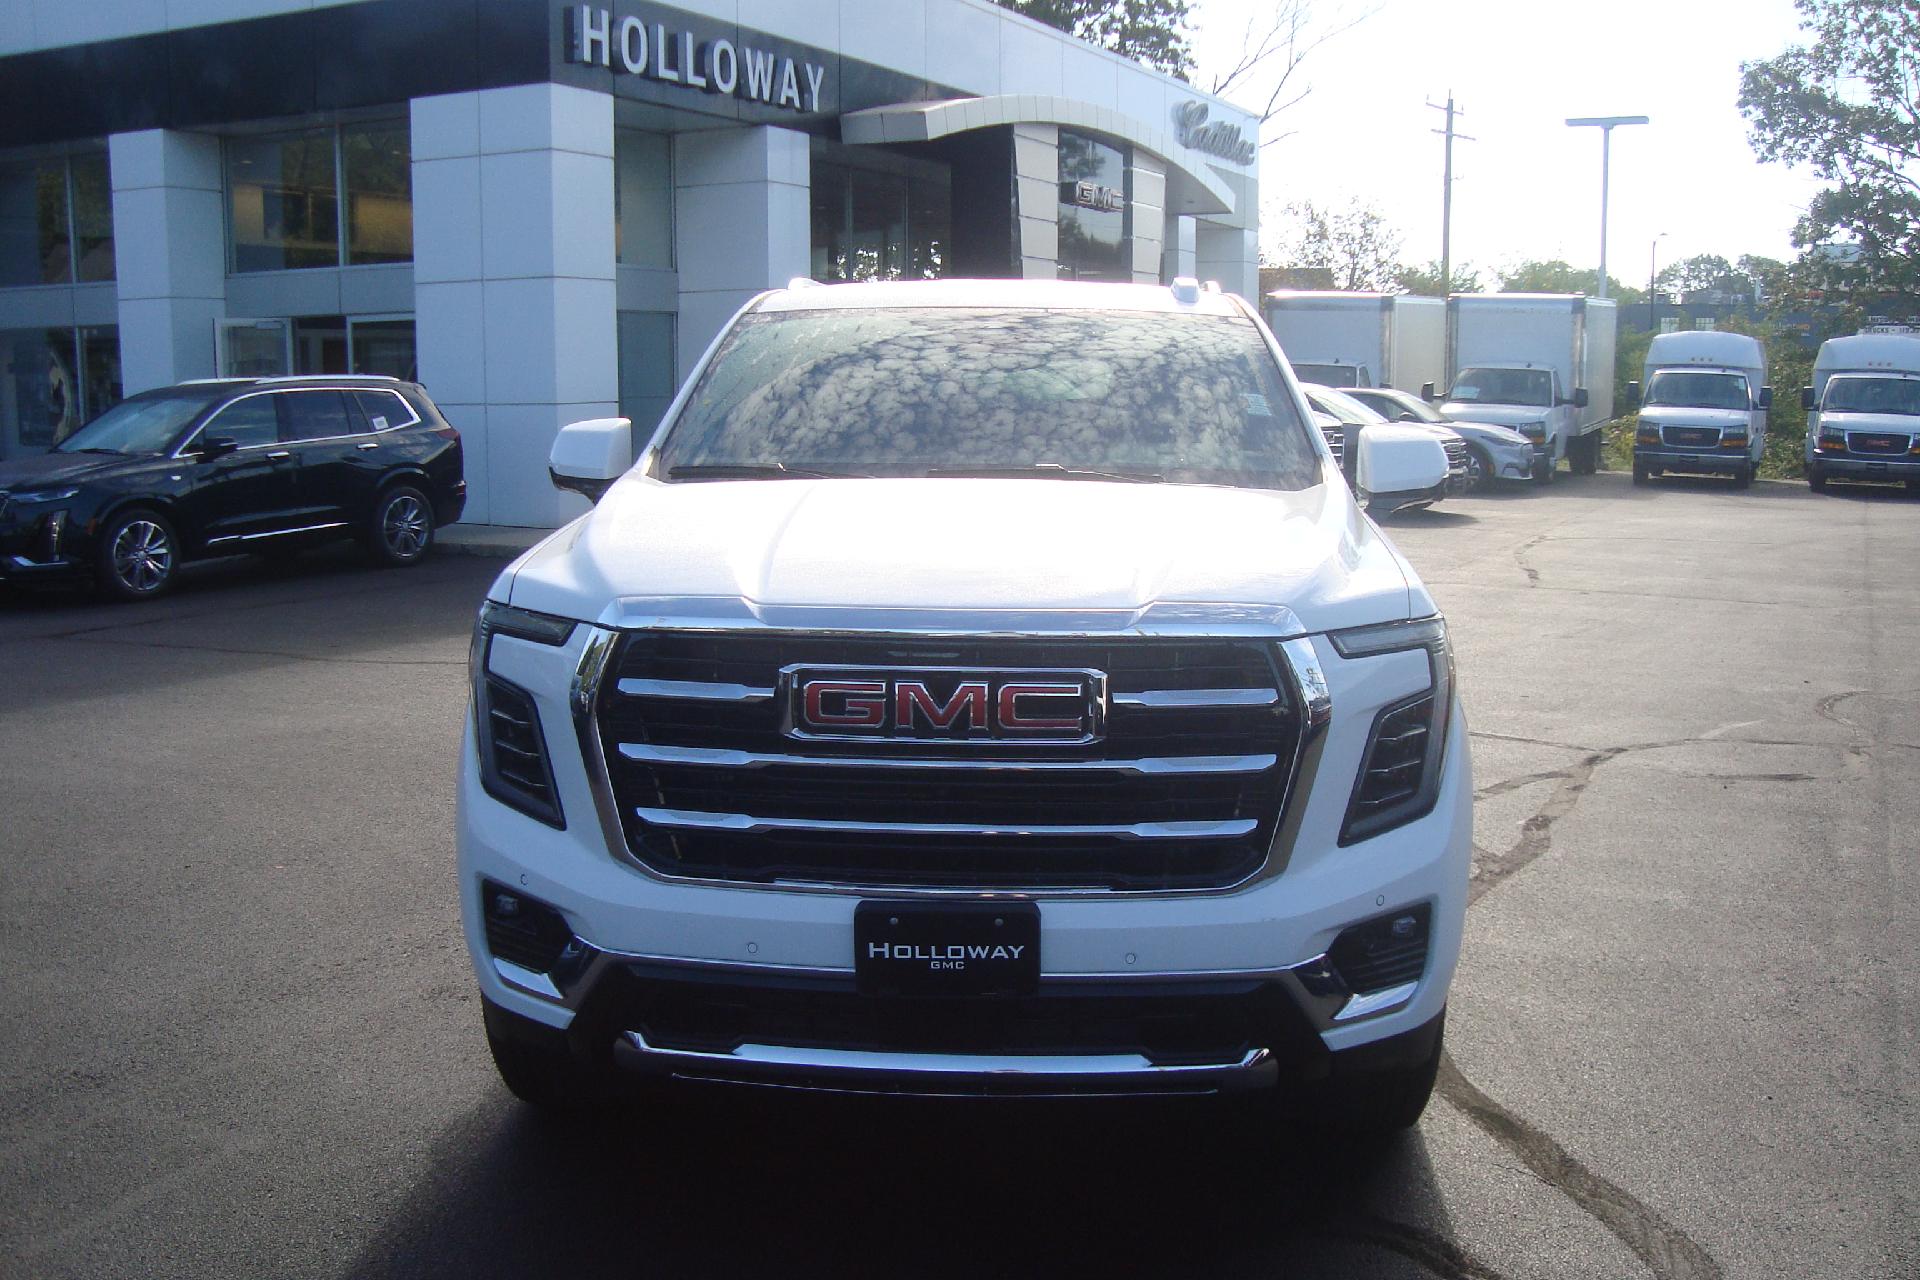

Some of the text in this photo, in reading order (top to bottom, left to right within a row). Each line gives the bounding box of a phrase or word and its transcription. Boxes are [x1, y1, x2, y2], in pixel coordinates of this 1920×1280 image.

[578, 4, 824, 112] HOLLOWAY
[1076, 181, 1124, 212] GMC
[803, 680, 1082, 731] GMC
[868, 942, 1025, 959] HOLLOWAY
[930, 961, 965, 970] GMC
